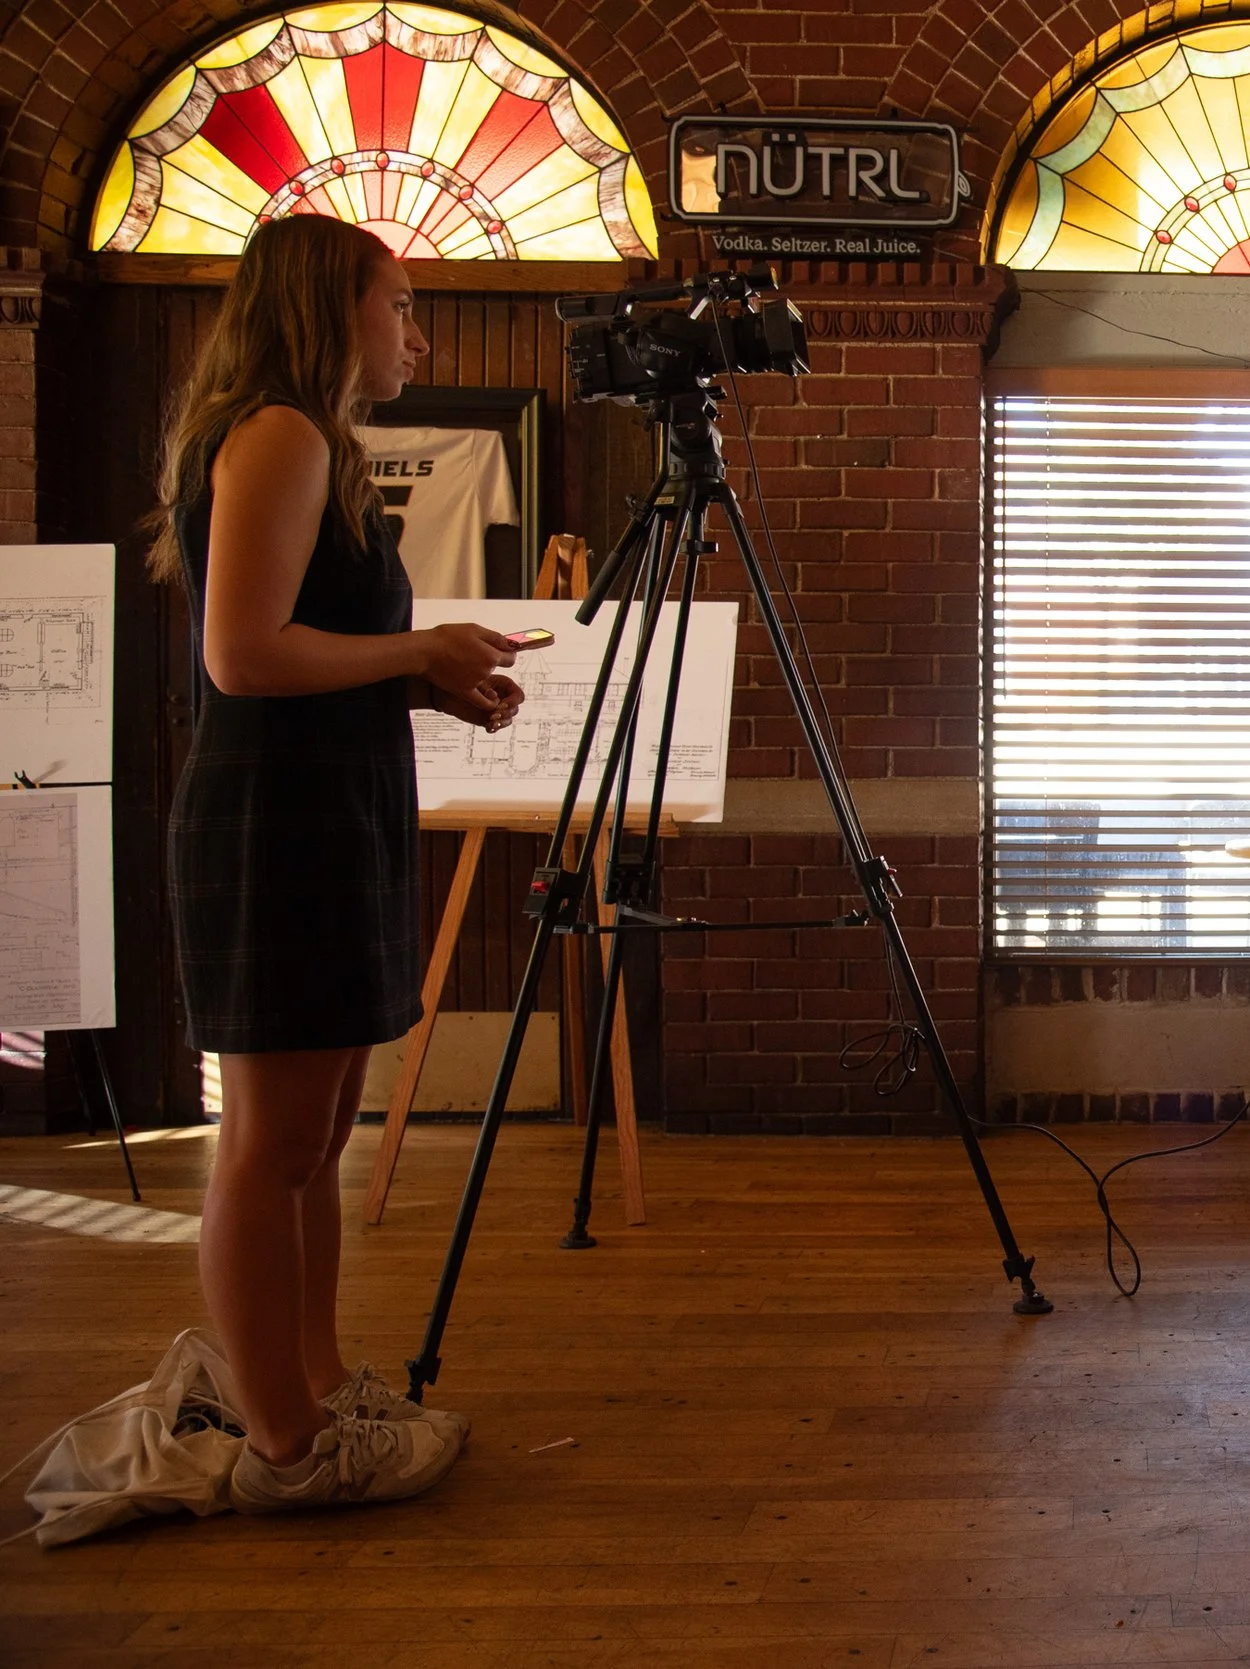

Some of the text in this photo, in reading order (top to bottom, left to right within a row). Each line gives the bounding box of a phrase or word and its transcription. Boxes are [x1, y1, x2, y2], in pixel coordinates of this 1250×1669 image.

[712, 236, 920, 254] Vodka. Seltzer. Real Juice.
[649, 343, 679, 357] SONY
